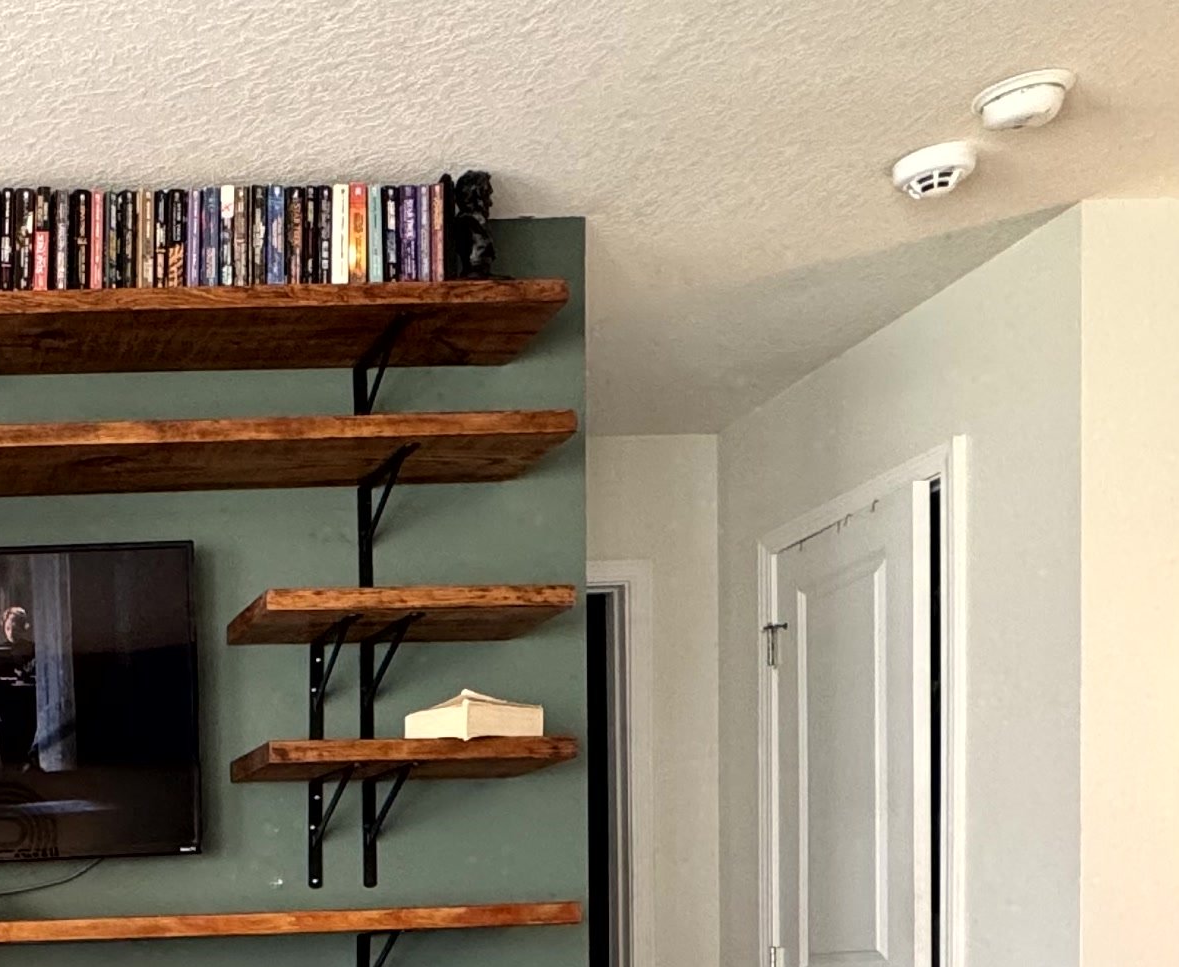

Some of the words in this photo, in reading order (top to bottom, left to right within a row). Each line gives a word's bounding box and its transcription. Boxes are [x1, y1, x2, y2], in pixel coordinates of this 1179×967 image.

[293, 202, 301, 224] STAR
[293, 225, 301, 247] TREK
[35, 255, 44, 274] STAR
